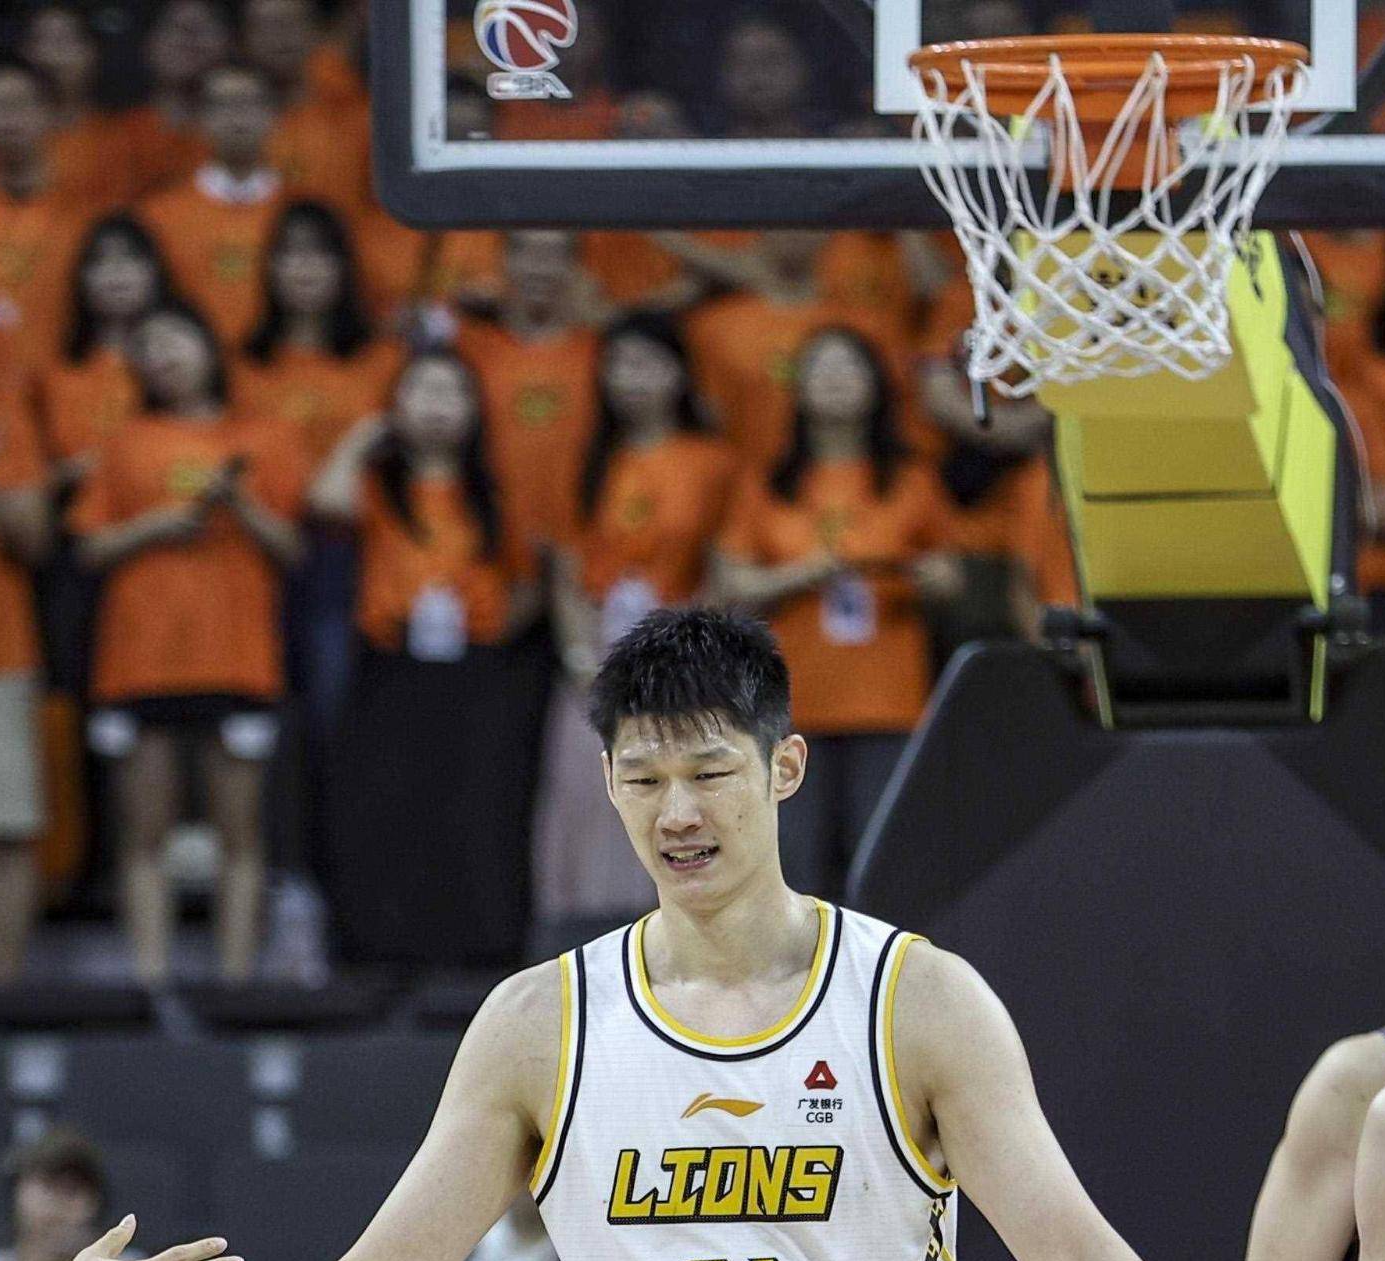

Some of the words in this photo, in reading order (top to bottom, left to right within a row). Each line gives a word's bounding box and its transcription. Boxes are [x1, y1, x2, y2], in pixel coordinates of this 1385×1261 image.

[797, 1098, 843, 1110] 广发银行
[806, 1112, 833, 1123] CGB
[607, 1145, 844, 1225] LIONS
